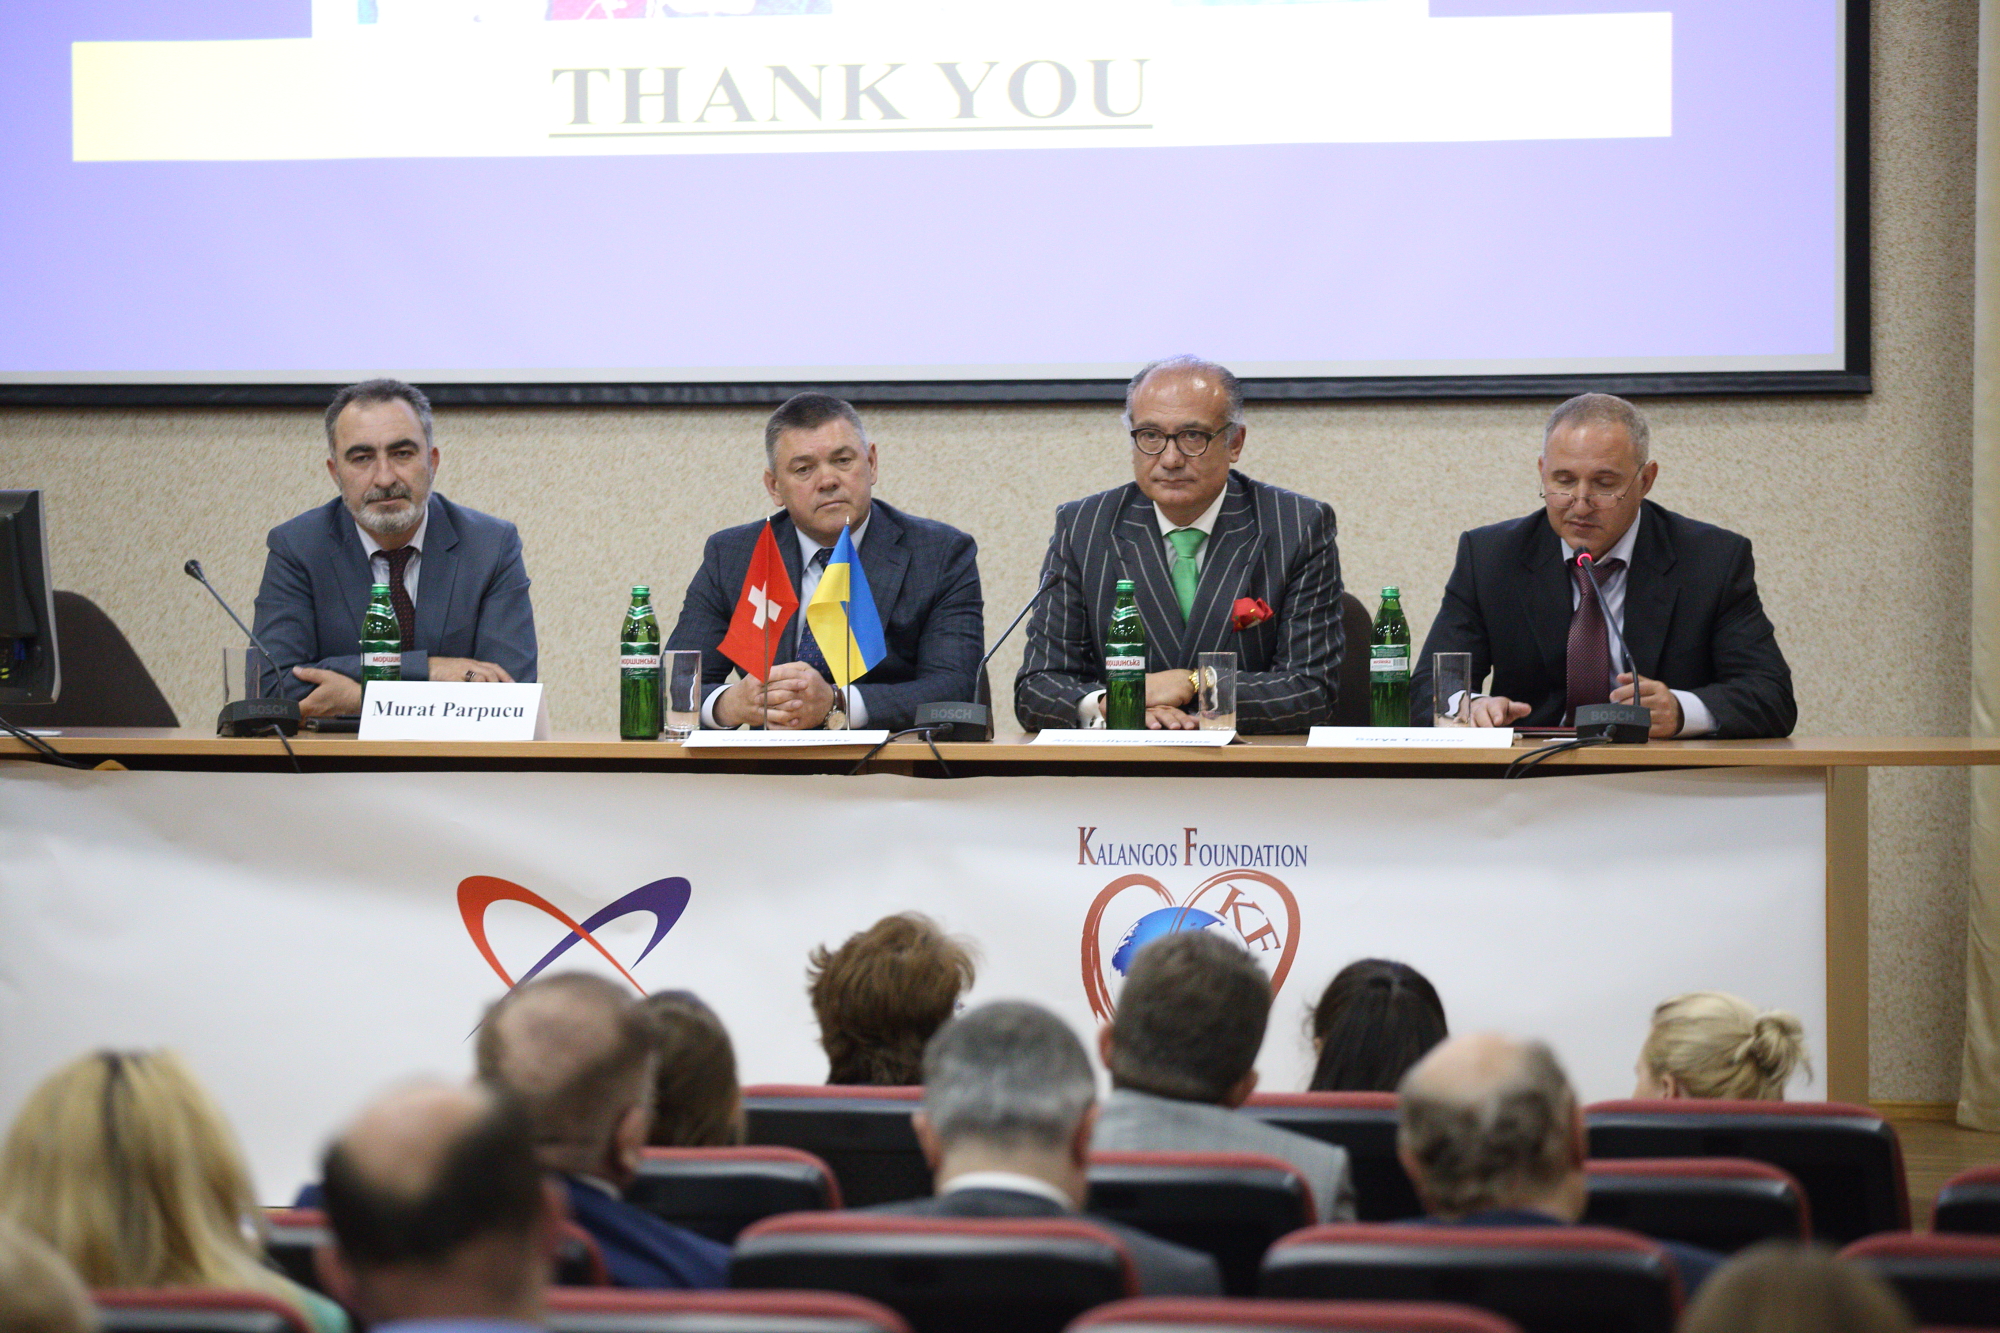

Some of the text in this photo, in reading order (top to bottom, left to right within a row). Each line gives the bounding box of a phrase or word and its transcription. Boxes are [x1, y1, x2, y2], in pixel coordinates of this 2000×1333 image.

[552, 58, 1152, 126] THANK YOU
[1106, 659, 1140, 667] оршинська
[247, 704, 289, 715] BOSCH
[372, 700, 524, 722] Murat Parpucu
[930, 708, 972, 719] BOSCH
[1591, 710, 1636, 721] BOSCH
[1077, 826, 1308, 868] KALANGOS FOUNDATION
[1214, 883, 1281, 951] KF
